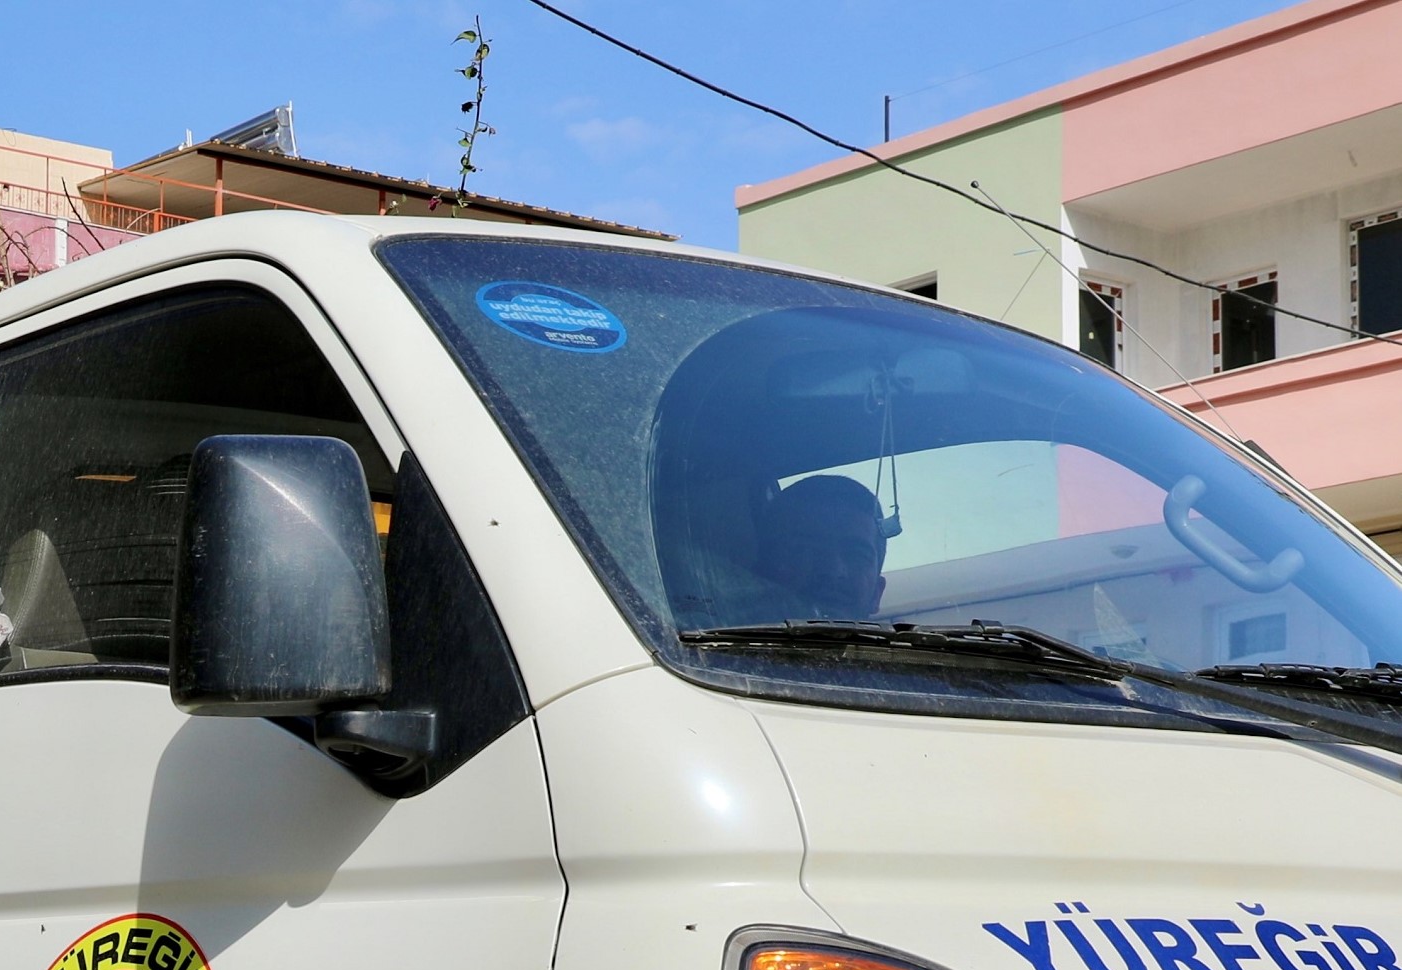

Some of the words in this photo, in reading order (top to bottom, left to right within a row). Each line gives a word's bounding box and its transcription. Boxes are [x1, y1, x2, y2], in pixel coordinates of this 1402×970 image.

[489, 302, 563, 315] uydudan
[564, 306, 607, 320] takip
[499, 311, 611, 329] edilmektedir
[544, 331, 596, 342] arvento
